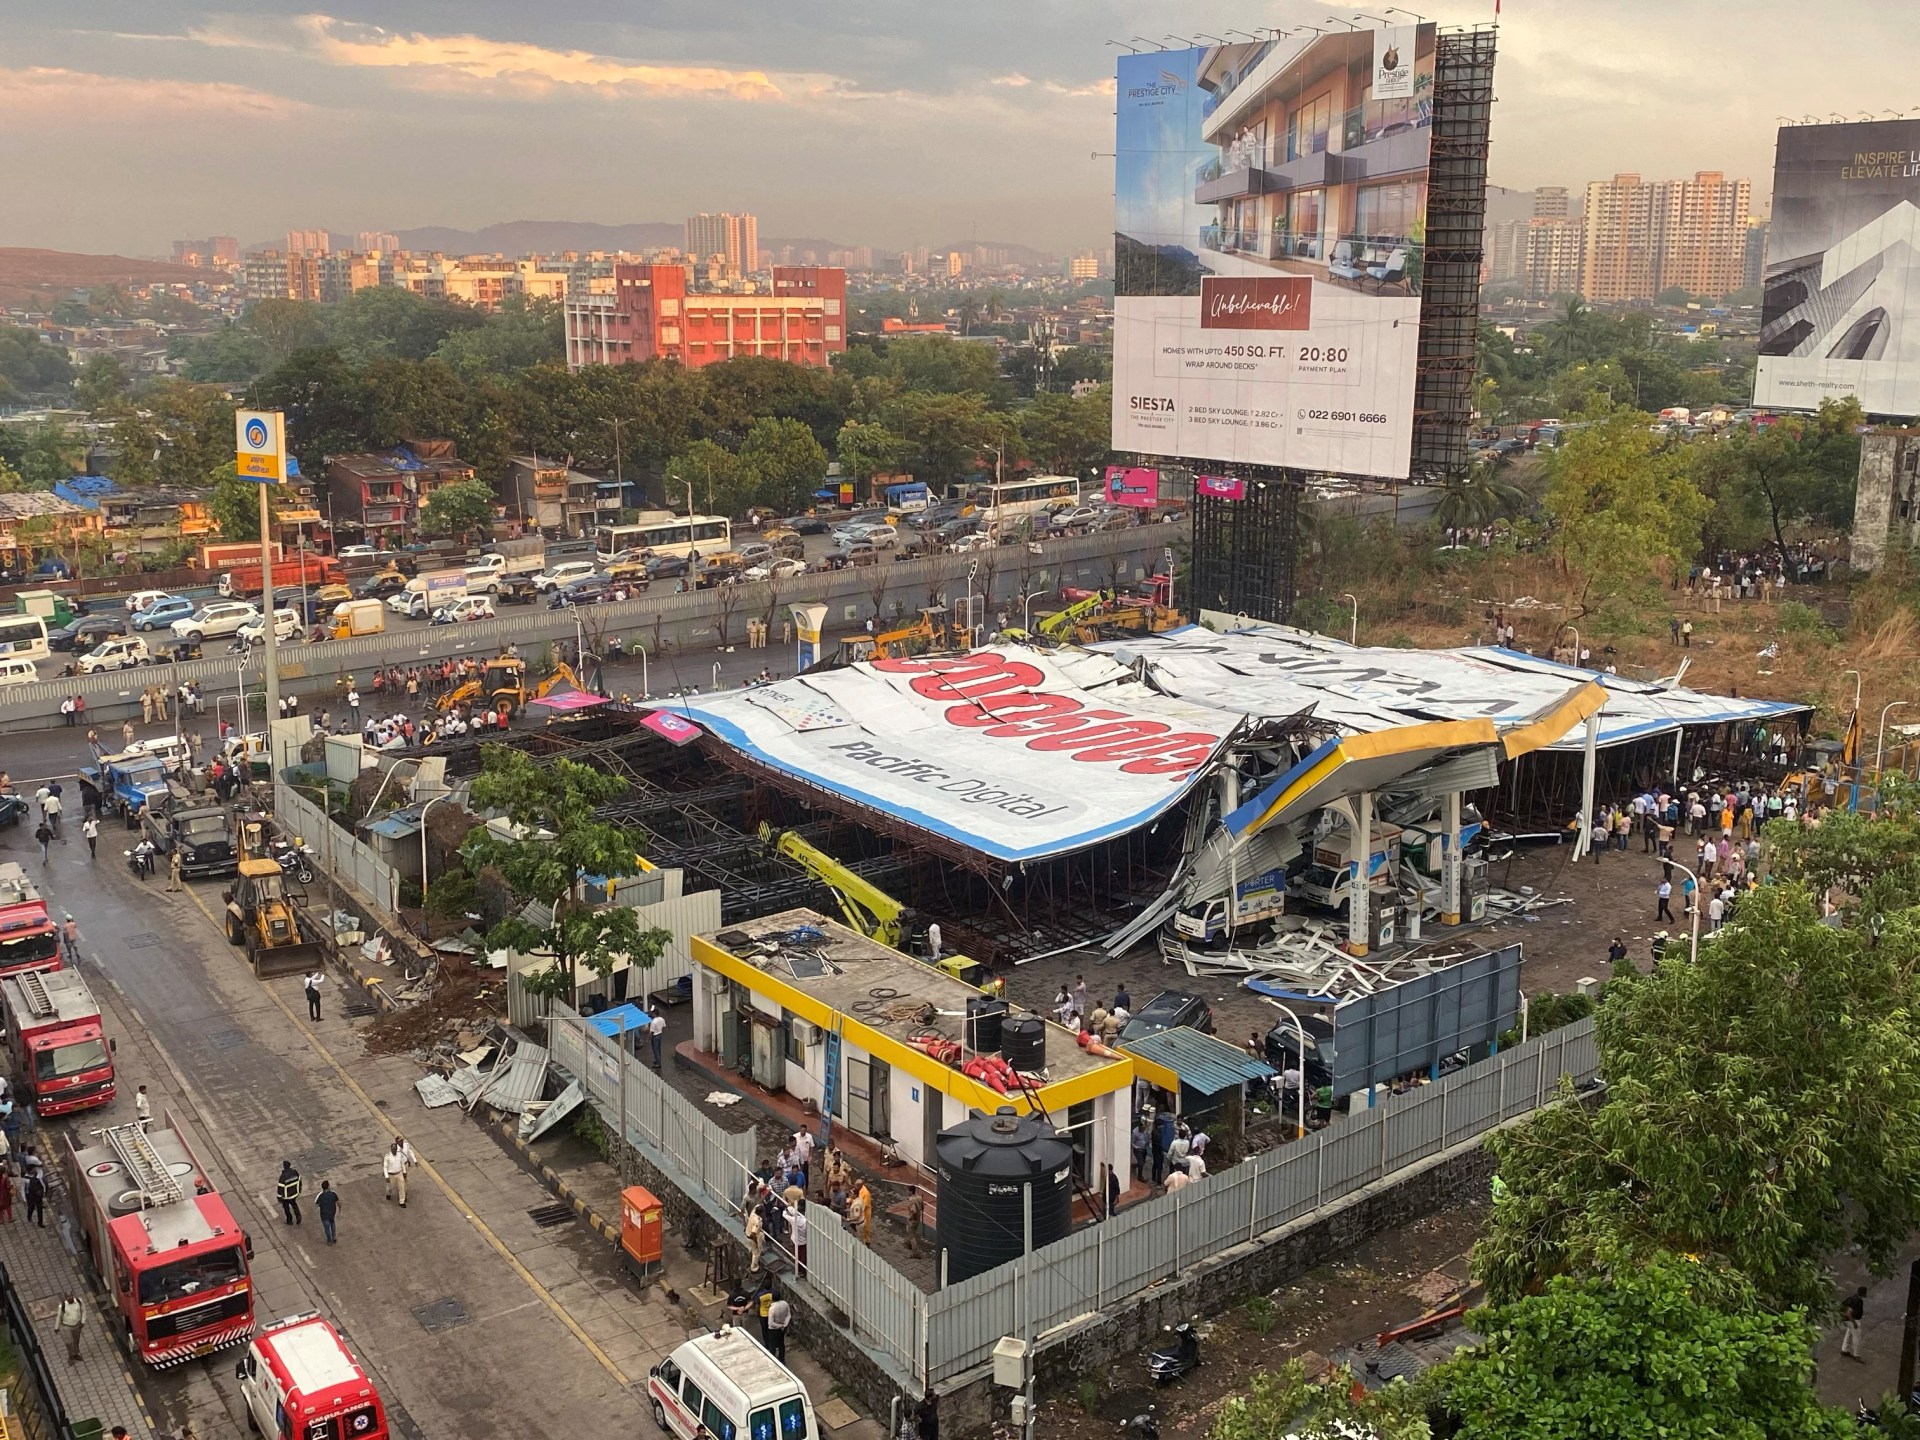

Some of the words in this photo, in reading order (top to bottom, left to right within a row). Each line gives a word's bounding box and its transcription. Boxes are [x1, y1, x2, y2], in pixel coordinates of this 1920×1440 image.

[1378, 68, 1408, 80] Prestige
[1128, 88, 1159, 98] PRESTIGE
[1160, 85, 1176, 95] CITY
[1854, 150, 1906, 165] INSPIRE
[1841, 164, 1899, 180] ELEVATE
[1210, 294, 1300, 317] Unbelievable!
[1224, 346, 1244, 356] 450
[1246, 346, 1266, 358] SQ.
[1269, 346, 1286, 358] FT.
[1206, 362, 1233, 370] AROUND
[1778, 380, 1854, 390] www.sheth-realty.com
[1130, 396, 1175, 412] SIESTA
[1308, 410, 1328, 420] 022
[1331, 411, 1356, 422] 6901
[1359, 413, 1387, 424] 6666
[828, 741, 950, 783] Pacific
[936, 778, 1068, 819] Digital
